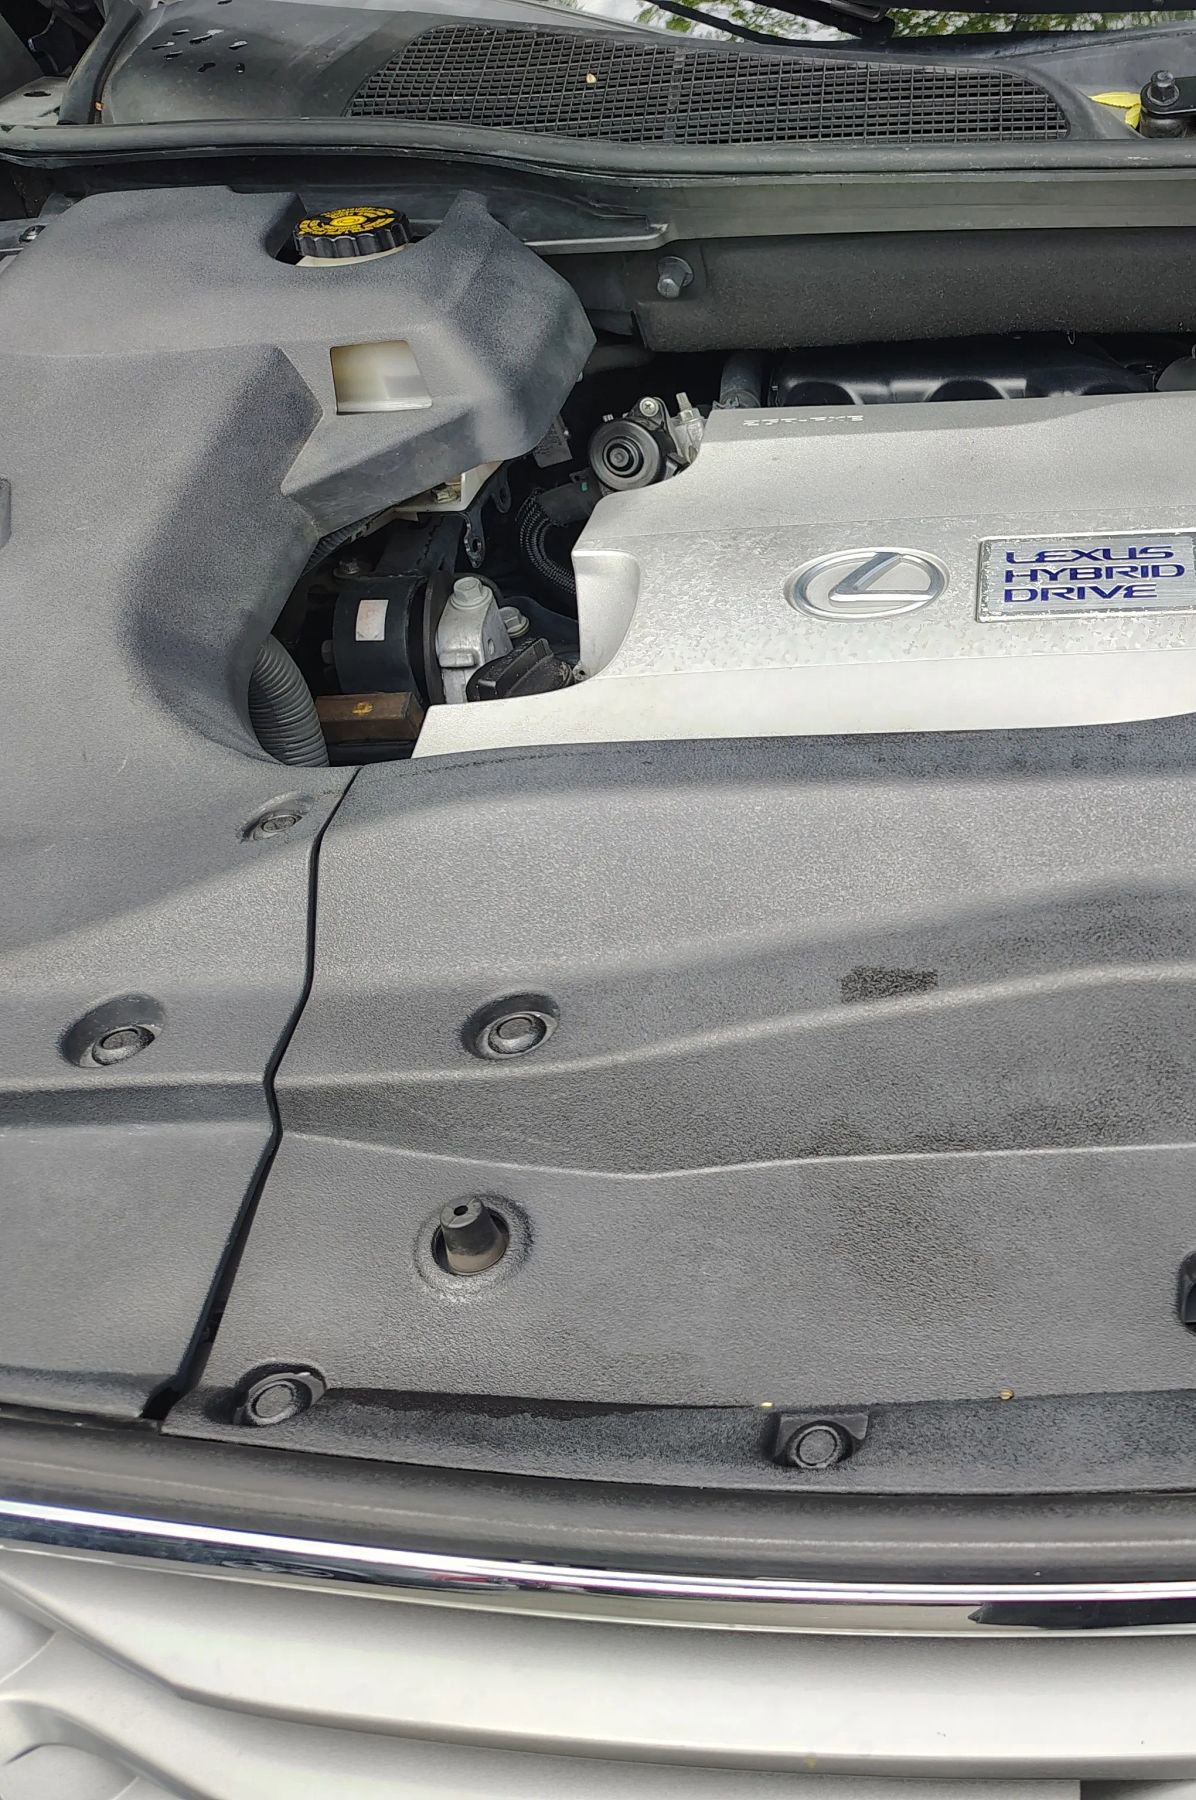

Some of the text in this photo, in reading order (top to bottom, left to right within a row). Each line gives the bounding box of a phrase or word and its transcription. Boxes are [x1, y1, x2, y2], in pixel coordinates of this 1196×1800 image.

[1006, 545, 1174, 564] LEXUS
[1004, 563, 1185, 583] HYBRID
[1003, 583, 1158, 603] DRIVE
